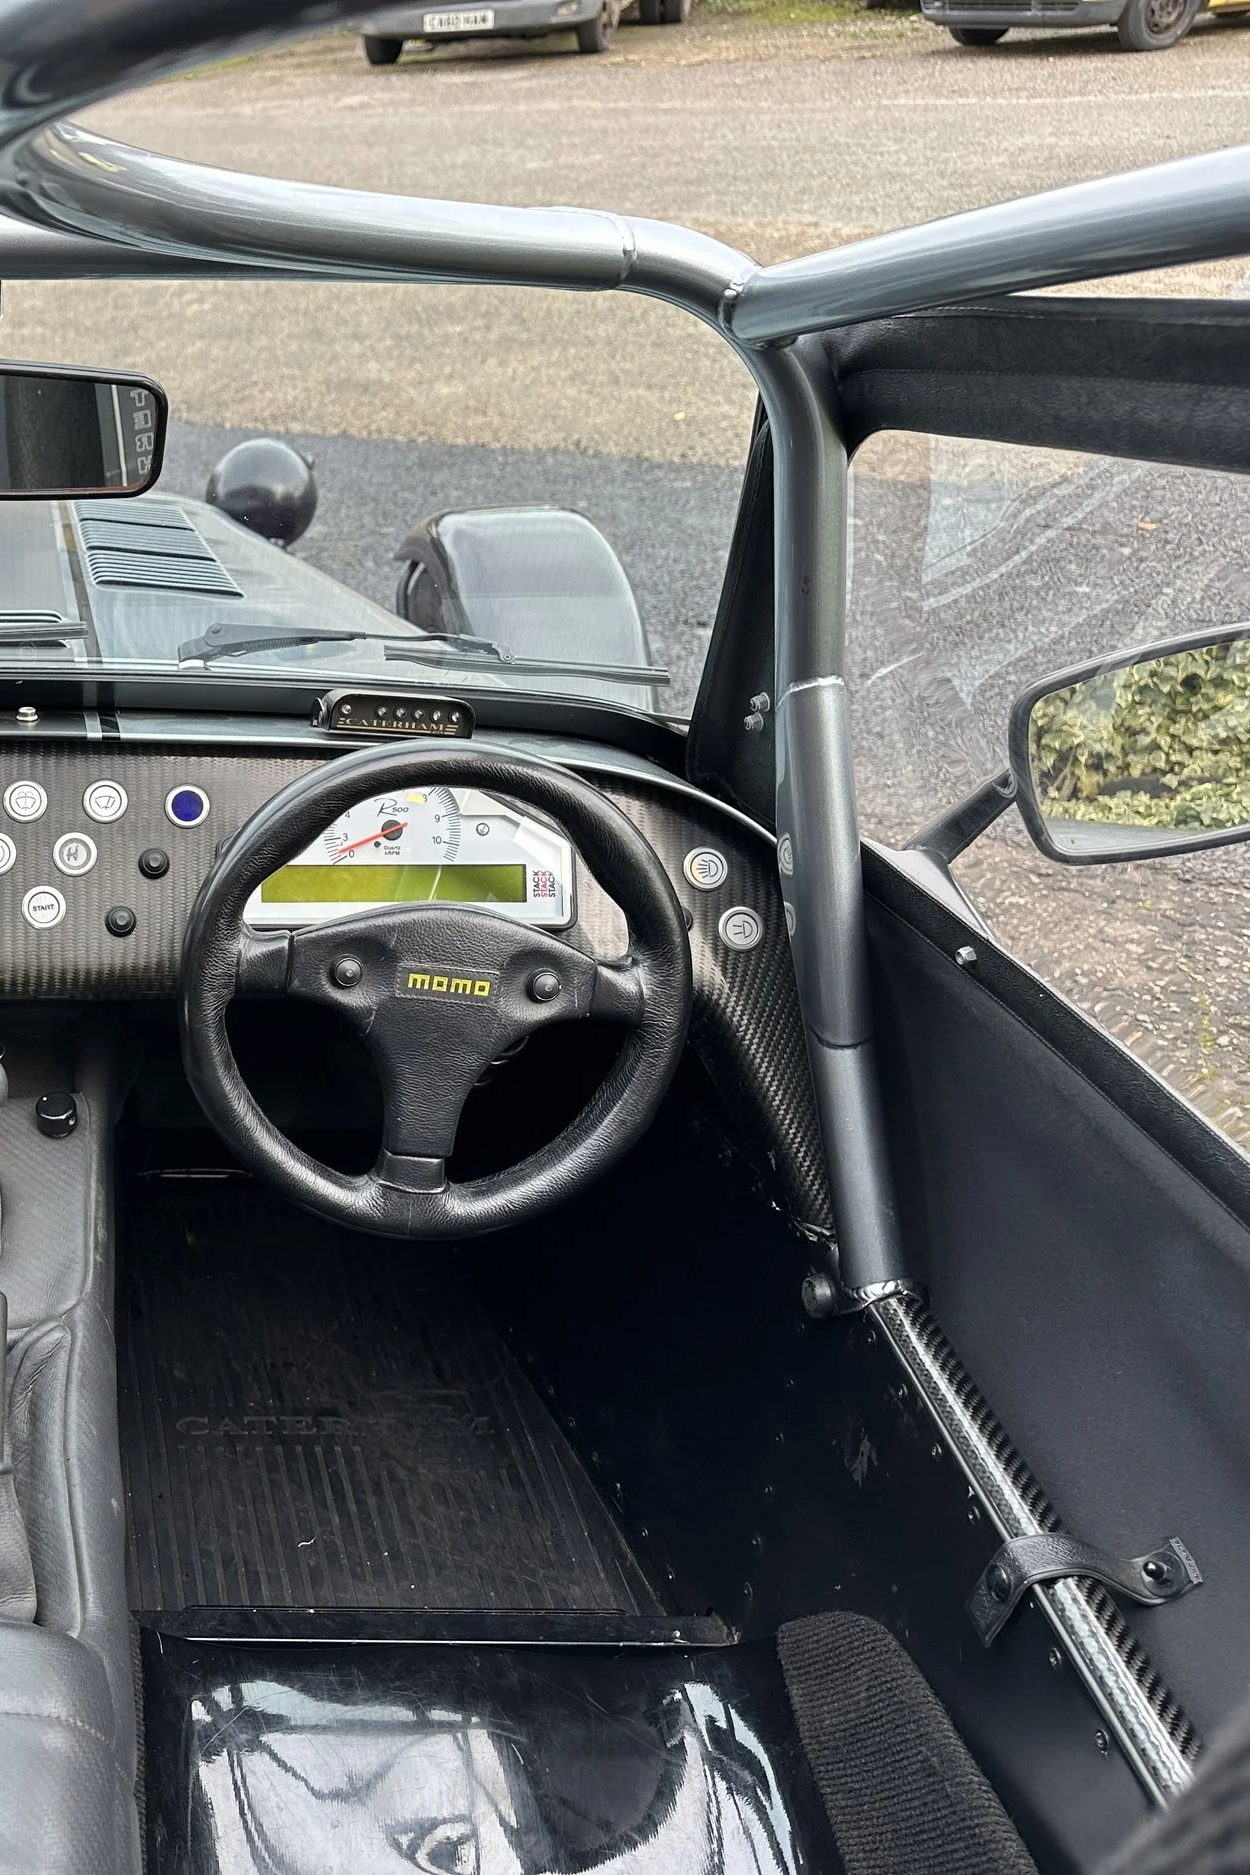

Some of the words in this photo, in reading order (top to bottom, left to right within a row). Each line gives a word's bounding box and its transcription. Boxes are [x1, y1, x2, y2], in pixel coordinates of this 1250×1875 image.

[346, 717, 443, 731] CATERHAM
[373, 798, 410, 817] R500
[434, 814, 441, 824] 9
[342, 832, 349, 842] 3
[432, 835, 443, 845] 10
[348, 849, 355, 859] 0
[532, 870, 540, 898] STACK
[32, 903, 55, 912] START
